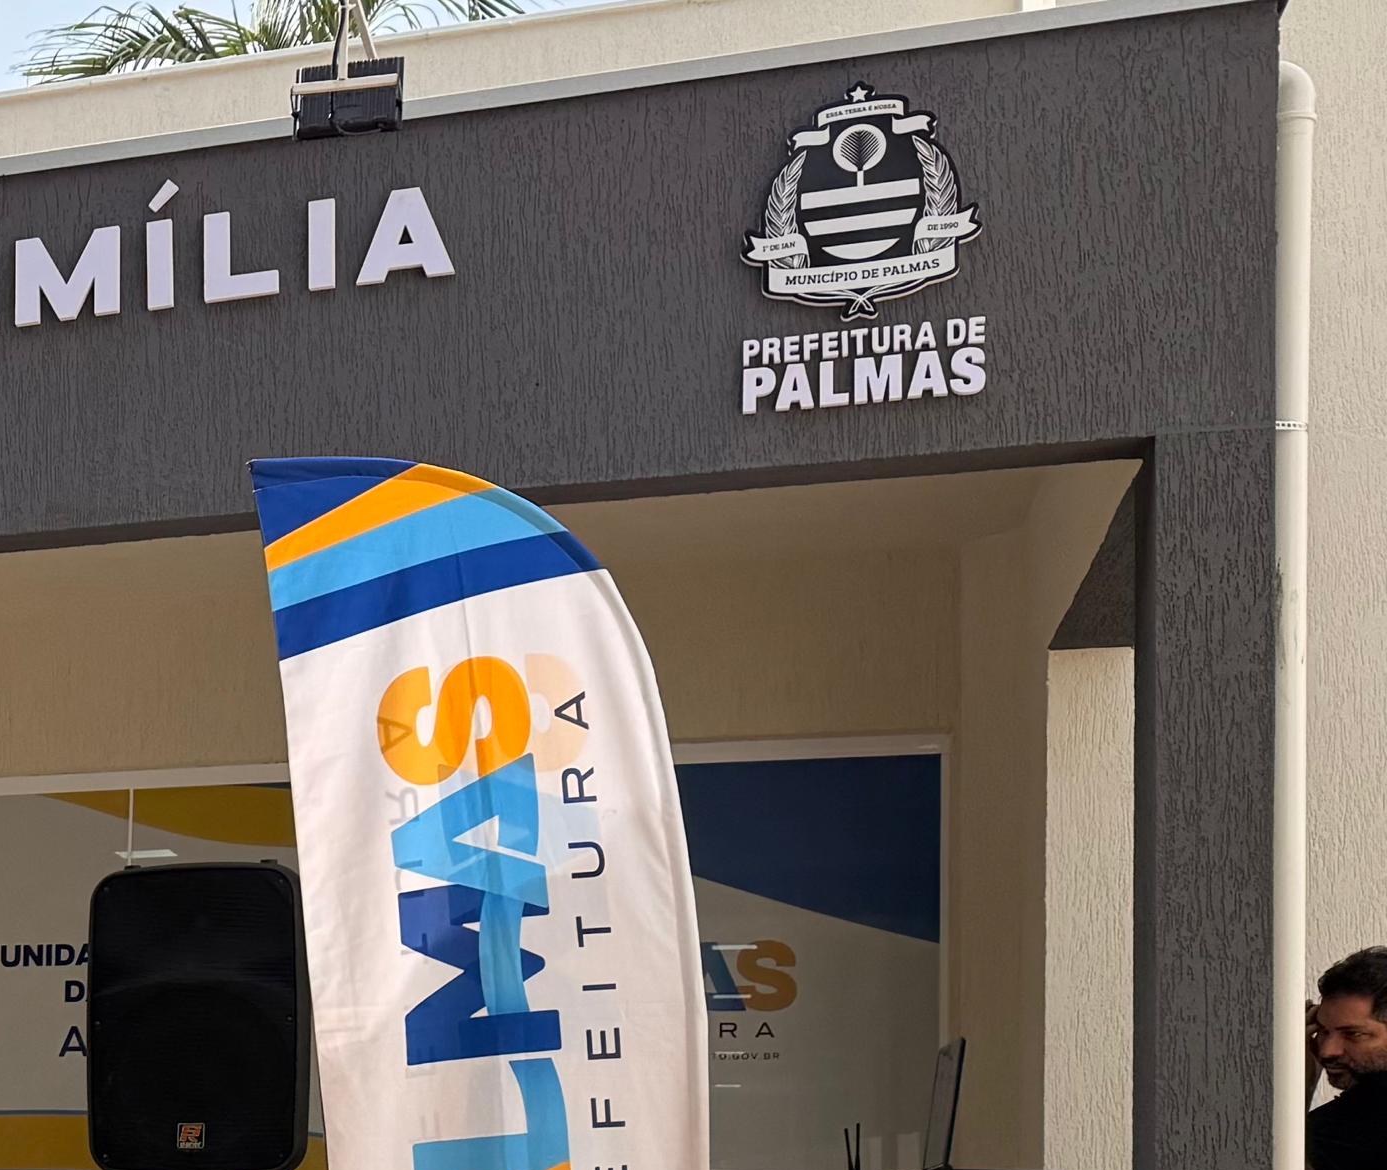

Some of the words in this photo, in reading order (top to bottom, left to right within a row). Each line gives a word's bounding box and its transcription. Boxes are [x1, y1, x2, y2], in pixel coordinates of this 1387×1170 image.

[785, 271, 858, 286] MUNICÍPIO
[862, 269, 879, 279] DE
[883, 258, 940, 277] PALMAS
[742, 321, 937, 367] PREFEITURA
[946, 315, 986, 347] DE
[742, 346, 987, 415] PALMAS
[64, 980, 88, 1003] D
